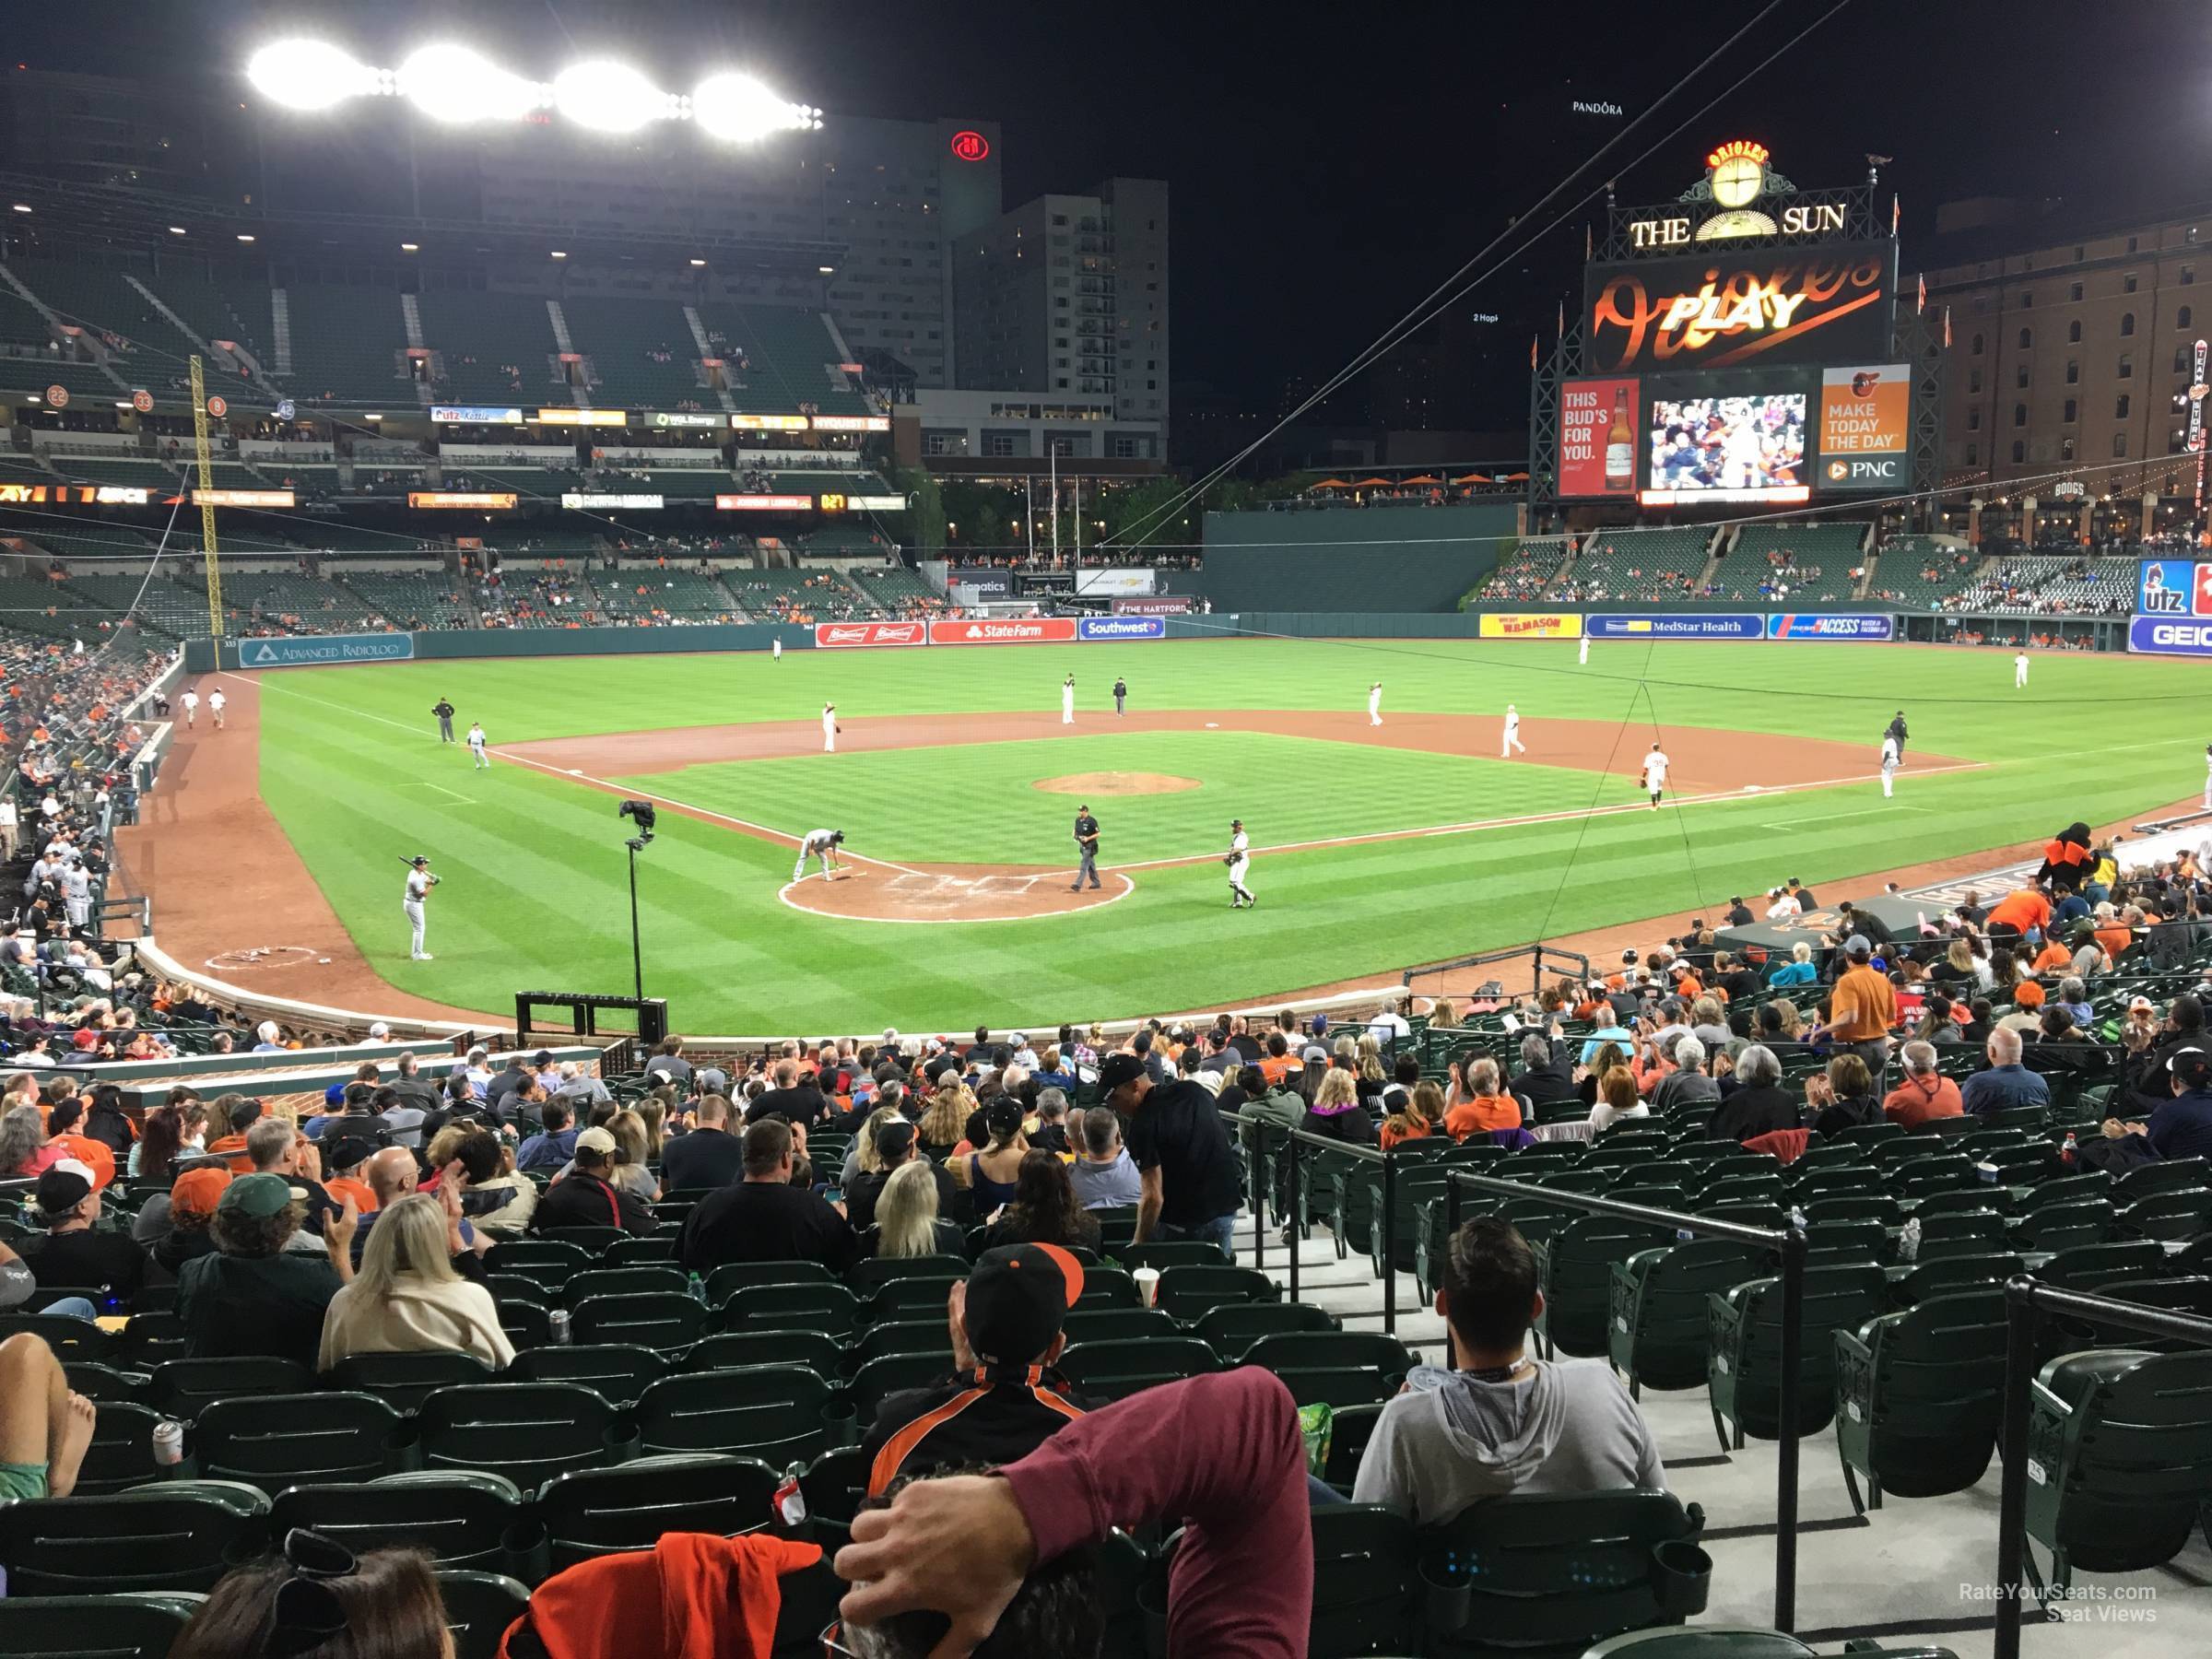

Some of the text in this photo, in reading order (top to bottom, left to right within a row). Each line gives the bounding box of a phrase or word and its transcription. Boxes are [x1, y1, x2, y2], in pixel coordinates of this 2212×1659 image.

[1709, 141, 1770, 167] ORIOLES
[1630, 204, 1846, 247] THE SUN
[1660, 292, 1808, 332] PLAY
[51, 391, 65, 401] 22
[138, 397, 150, 406] 33
[1565, 392, 1597, 407] THIS
[215, 402, 221, 411] 8
[280, 405, 292, 416] 42
[1829, 403, 1877, 418] MAKE
[1564, 409, 1607, 425] BUD'S
[2191, 402, 2201, 441] STORE
[1828, 418, 1880, 433] TODAY
[1564, 428, 1592, 442] FOR
[1827, 435, 1858, 450] THE
[1563, 444, 1595, 460] YOU.
[1851, 461, 1896, 477] PNC
[961, 581, 1006, 592] Fanatics
[1088, 621, 1149, 635] Southwest
[1653, 621, 1742, 631] MedStar Health
[1819, 618, 1860, 634] ACCESS
